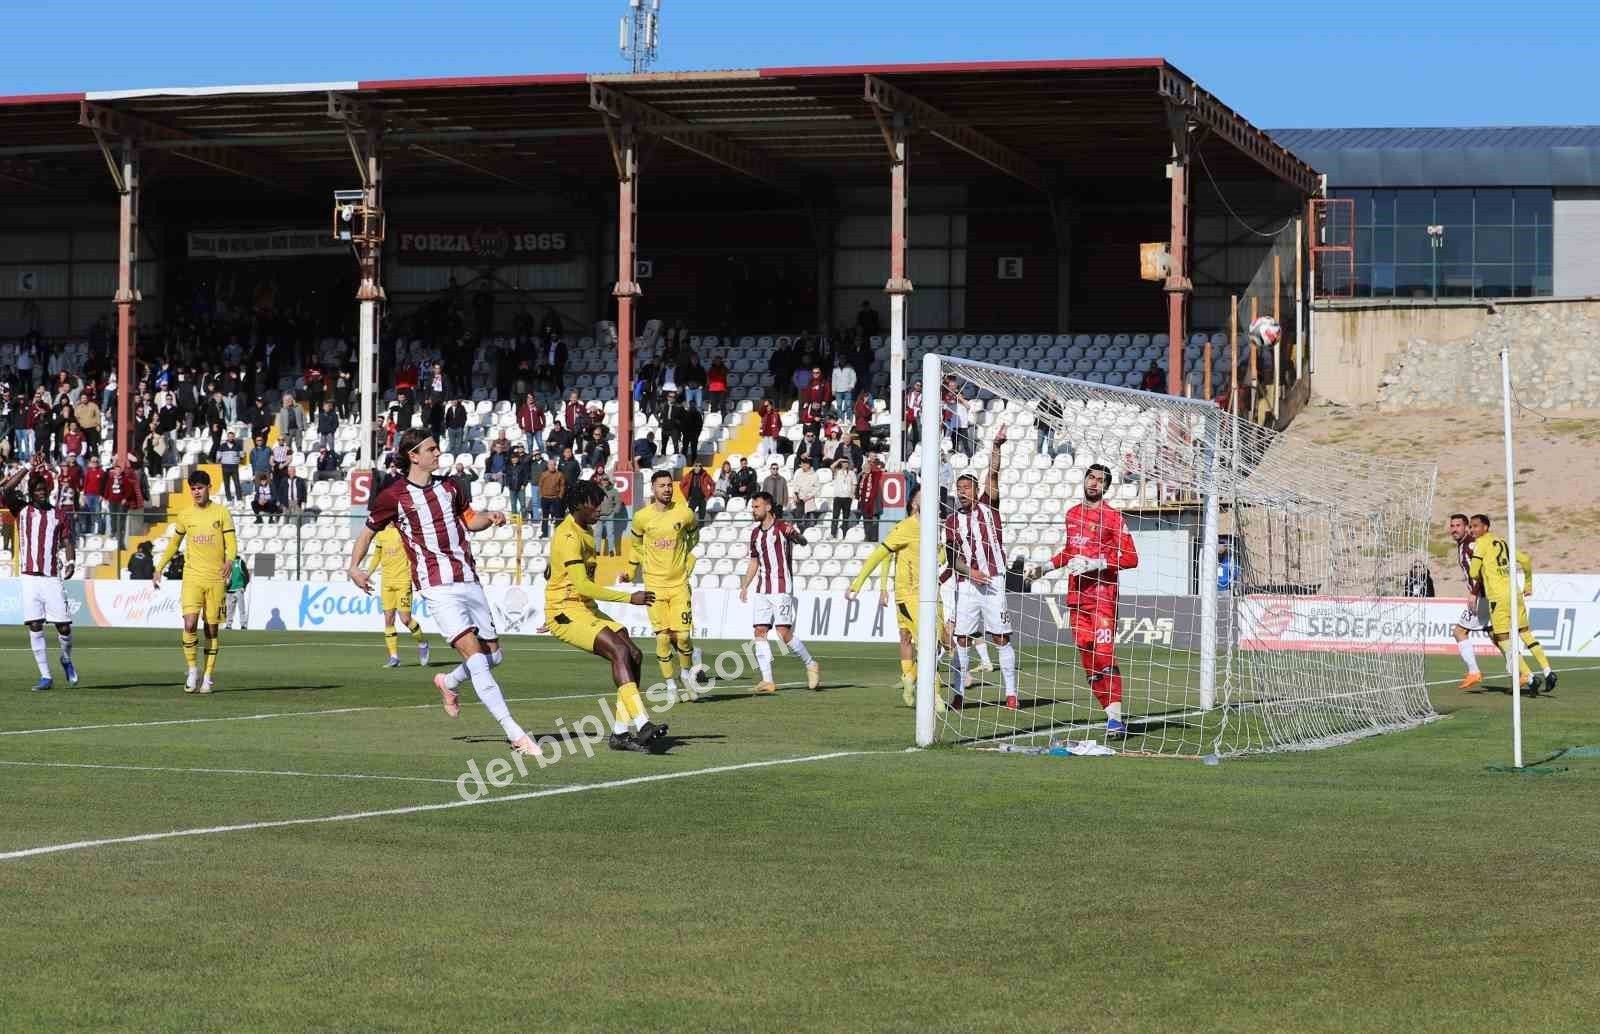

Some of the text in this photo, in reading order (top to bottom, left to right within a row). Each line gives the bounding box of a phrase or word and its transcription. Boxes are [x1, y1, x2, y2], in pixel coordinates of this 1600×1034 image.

[401, 233, 567, 251] FORZA 1965
[1005, 259, 1017, 278] E
[354, 476, 370, 502] S
[1096, 628, 1112, 644] 28
[1308, 616, 1385, 638] SEDEF
